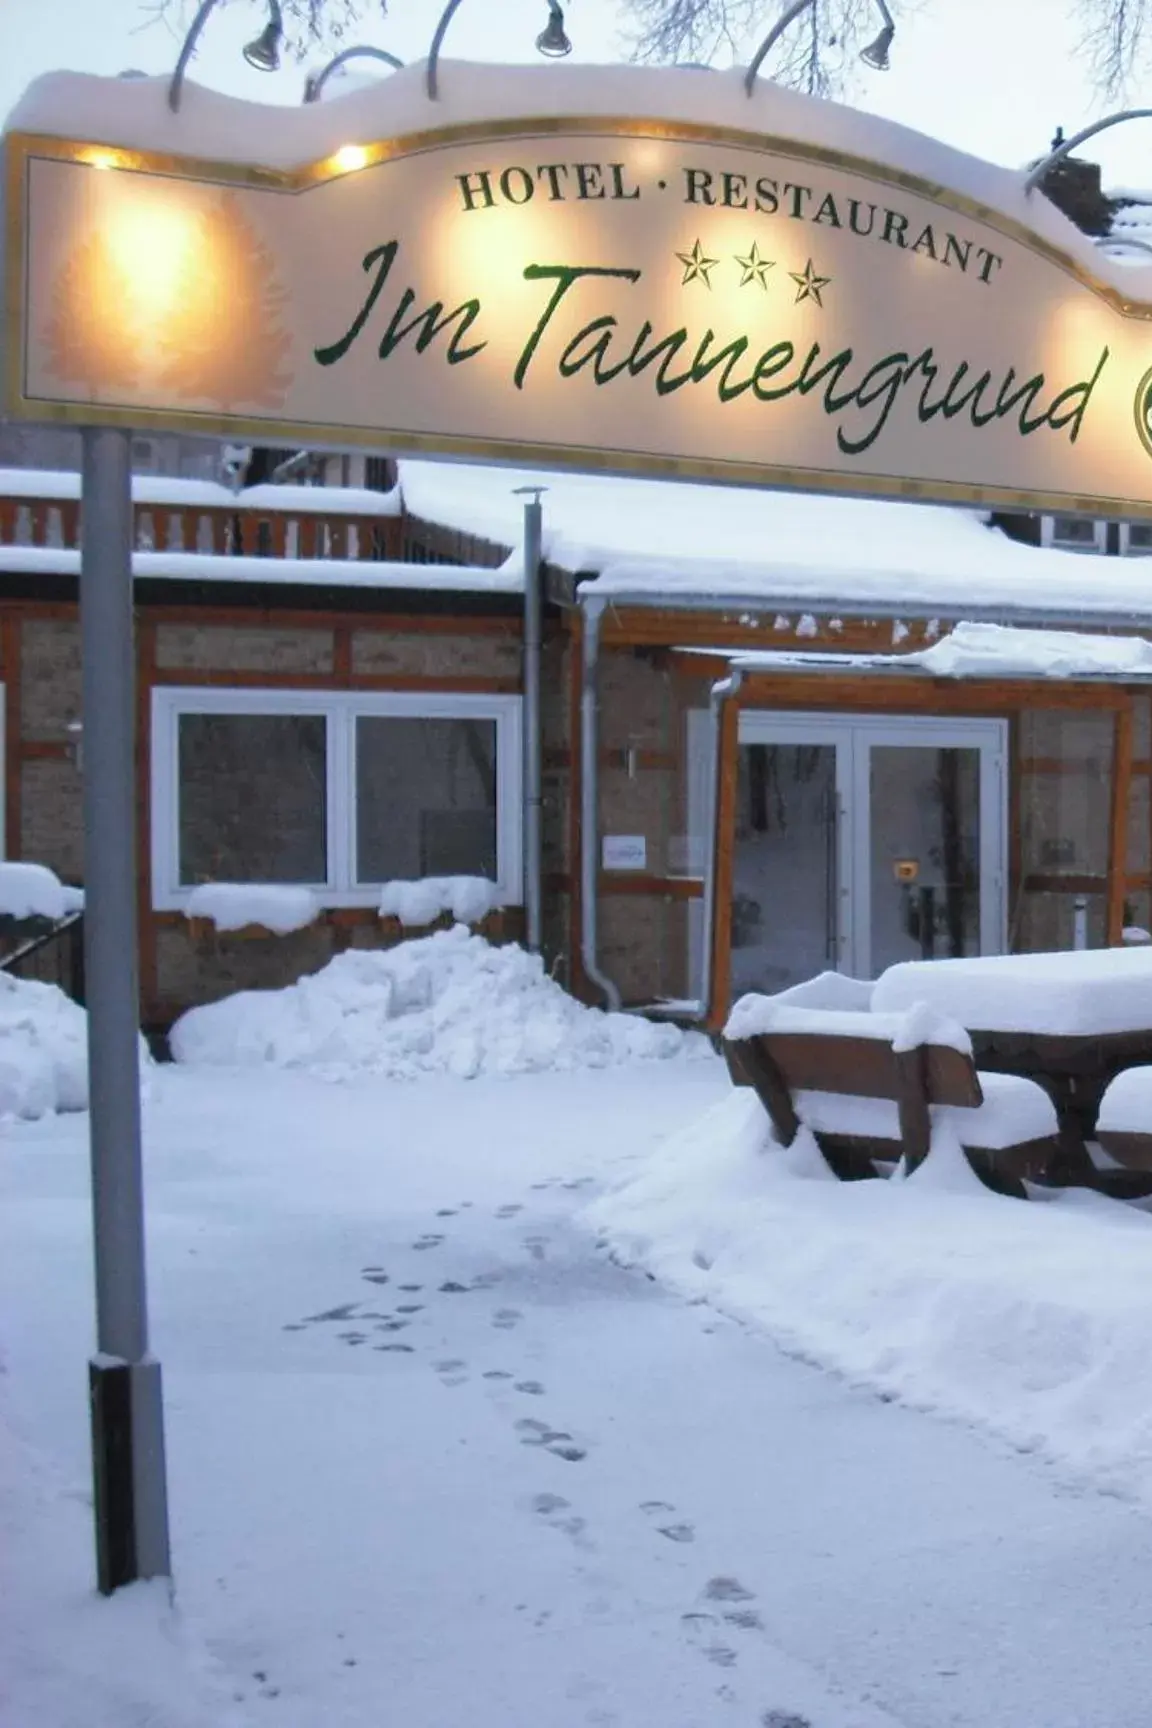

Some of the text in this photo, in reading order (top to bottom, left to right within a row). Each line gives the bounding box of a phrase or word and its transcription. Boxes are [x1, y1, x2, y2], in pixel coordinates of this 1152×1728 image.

[455, 162, 1003, 285] HOTEL RESTAURANT
[314, 240, 1109, 454] Im Tannengrund
